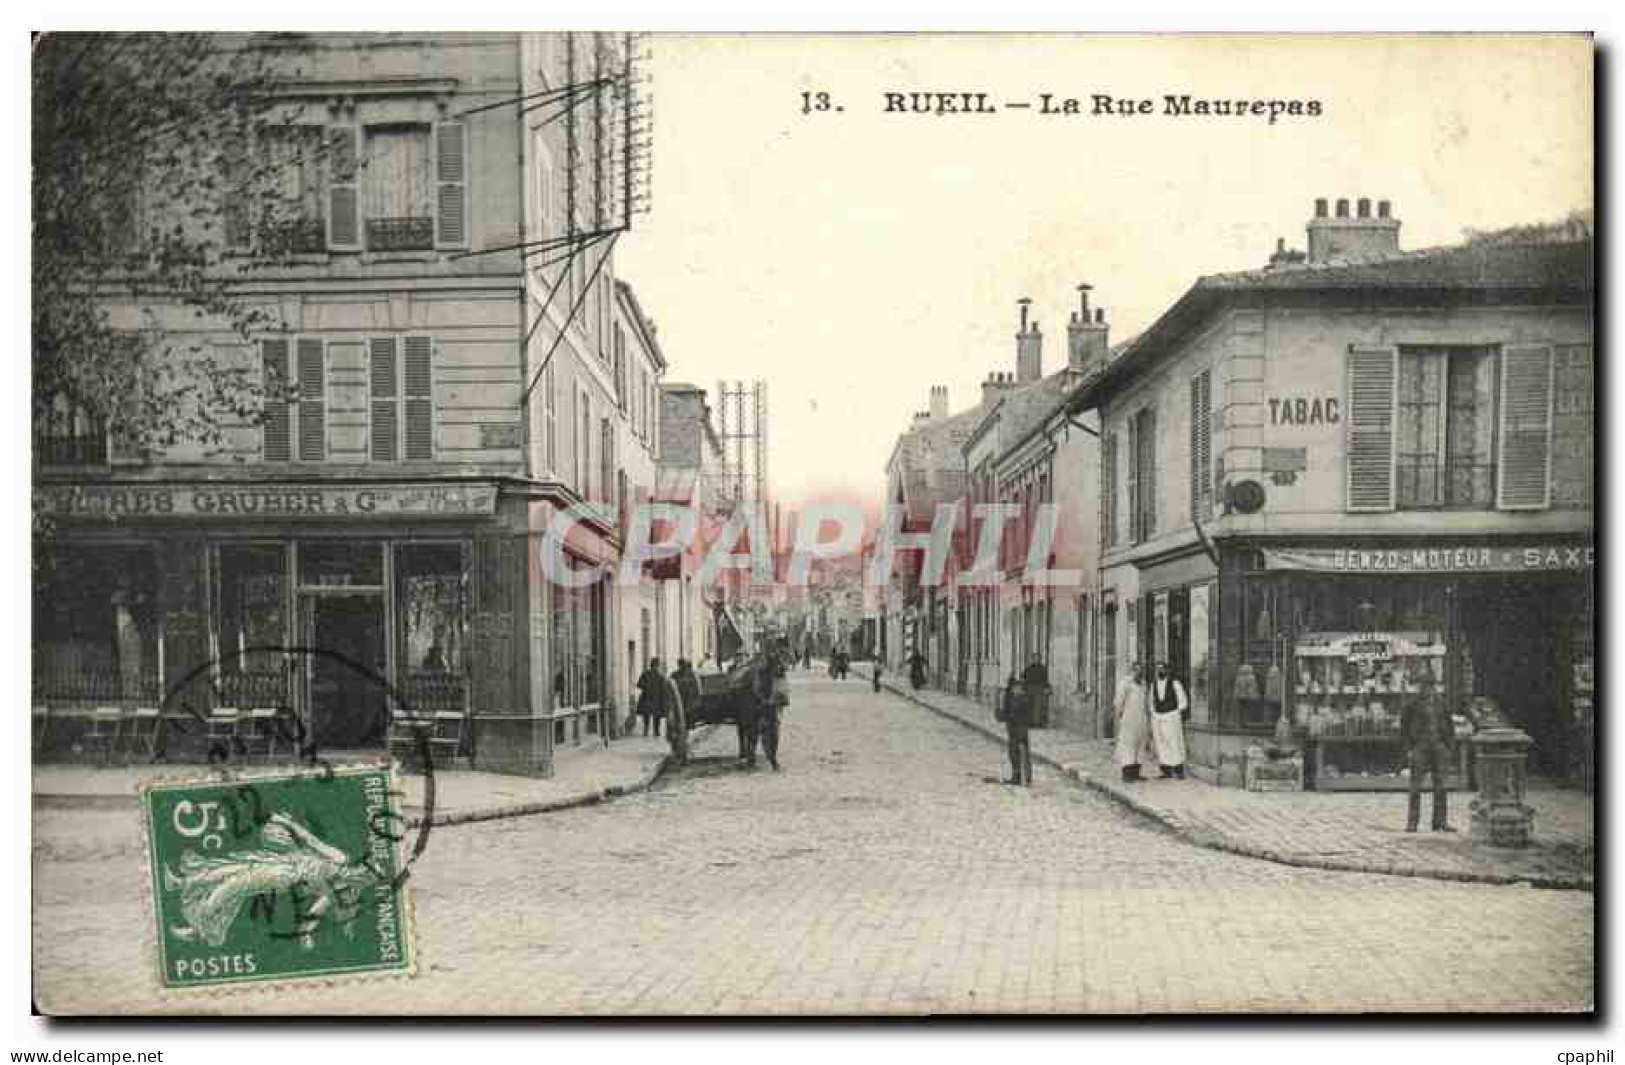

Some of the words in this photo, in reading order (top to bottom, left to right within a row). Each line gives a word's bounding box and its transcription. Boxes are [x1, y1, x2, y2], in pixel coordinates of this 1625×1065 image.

[1268, 397, 1340, 425] TABAC
[196, 491, 323, 514] GRUBER
[176, 954, 258, 977] POSTES
